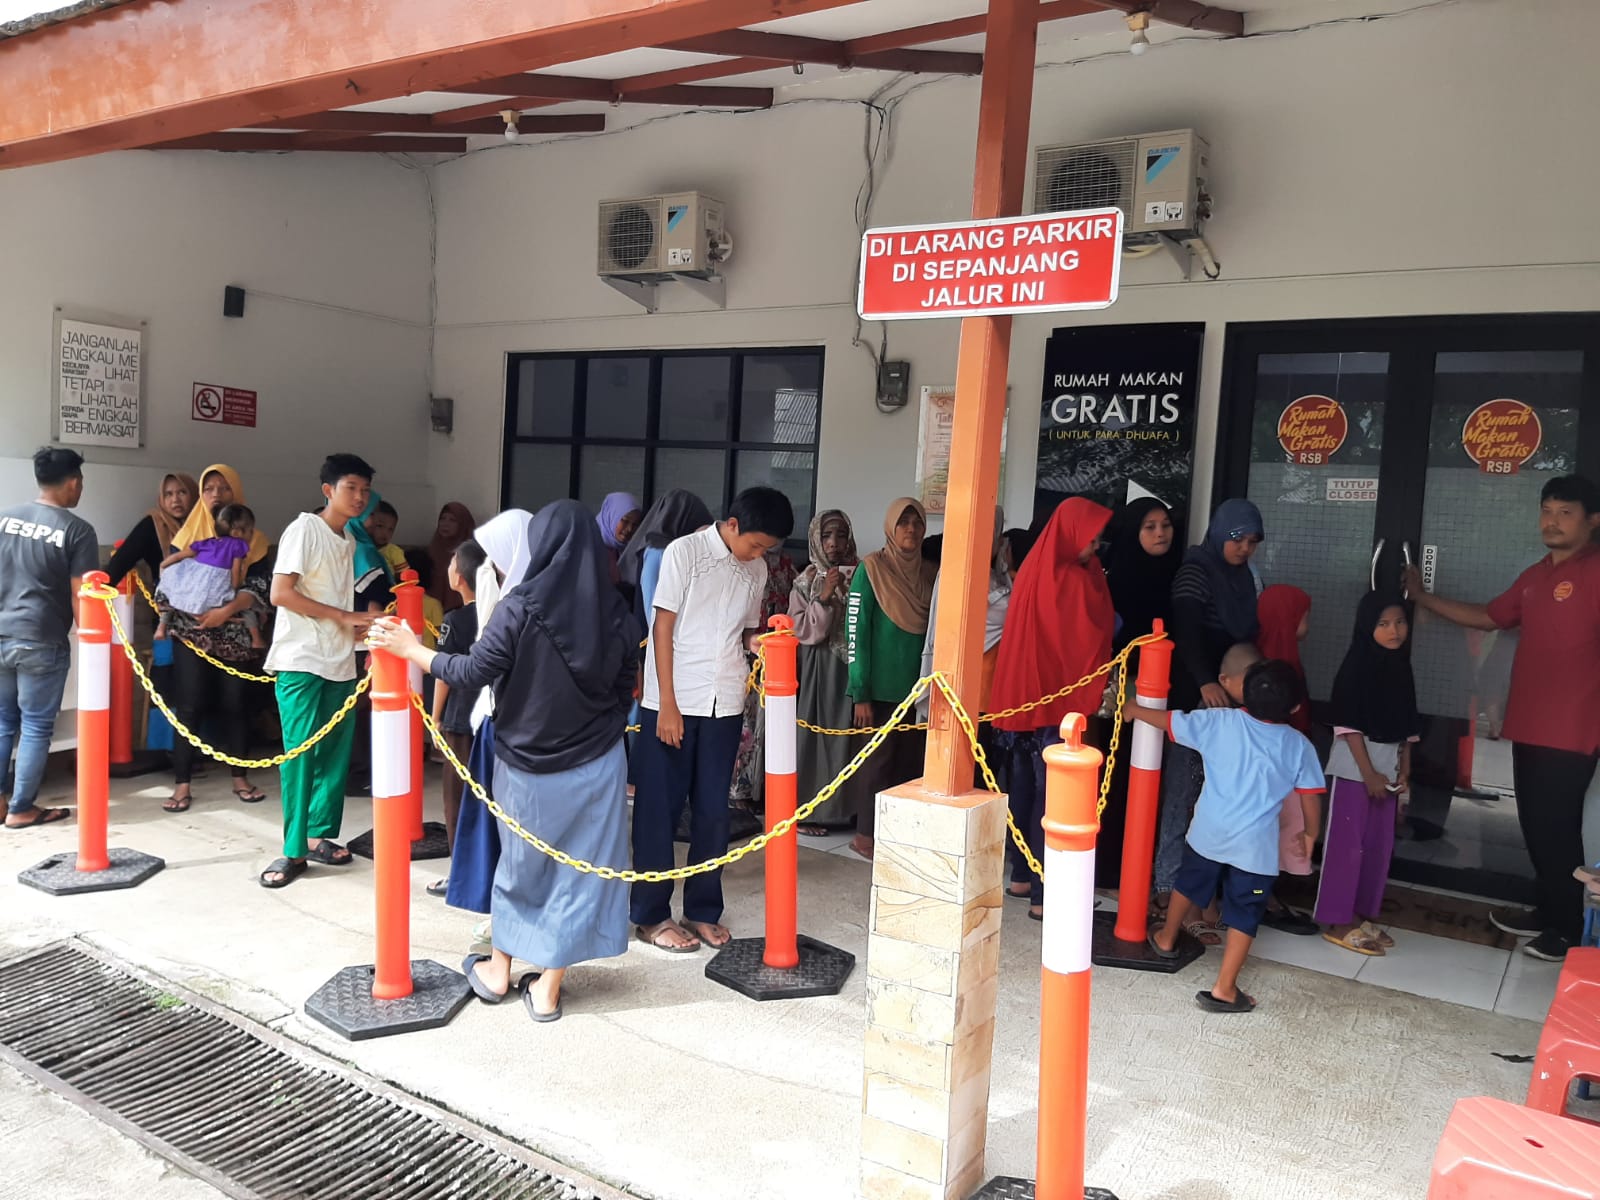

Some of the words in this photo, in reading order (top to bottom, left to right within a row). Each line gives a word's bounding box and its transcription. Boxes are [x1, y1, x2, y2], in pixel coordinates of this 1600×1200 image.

[870, 237, 893, 257] DI
[899, 229, 1003, 255] LARANG
[1012, 218, 1112, 246] PARKIR
[892, 263, 915, 283] DI
[922, 250, 1079, 281] SEPANJANG
[920, 284, 1004, 308] JALUR
[1011, 281, 1046, 303] INI
[62, 331, 138, 352] JANGANLAH
[62, 346, 114, 365] ENGKAU
[118, 353, 138, 369] ME
[104, 366, 138, 382] LIHAT
[1054, 373, 1110, 388] RUMAH
[1119, 371, 1184, 387] MAKAN
[62, 375, 104, 392] TETAPI
[80, 391, 138, 410] LIHATLAH
[1051, 393, 1180, 424] GRATIS
[88, 407, 138, 425] ENGKAU
[1288, 401, 1339, 425] Rumah
[1475, 406, 1533, 431] Rumah
[65, 420, 137, 438] BERMAKSIAT
[1056, 431, 1092, 440] UNTUK
[1095, 431, 1120, 440] PARA
[1126, 431, 1170, 441] DHUAFA
[1278, 422, 1326, 438] Makan
[1462, 426, 1519, 444] Makan
[1290, 434, 1338, 451] Gratis
[1475, 442, 1530, 459] Gratis
[1300, 452, 1322, 464] RSB
[1486, 460, 1512, 473] RSB
[1333, 481, 1374, 489] TUTUP
[1328, 490, 1377, 500] CLOSED
[848, 592, 861, 664] INDONESIA
